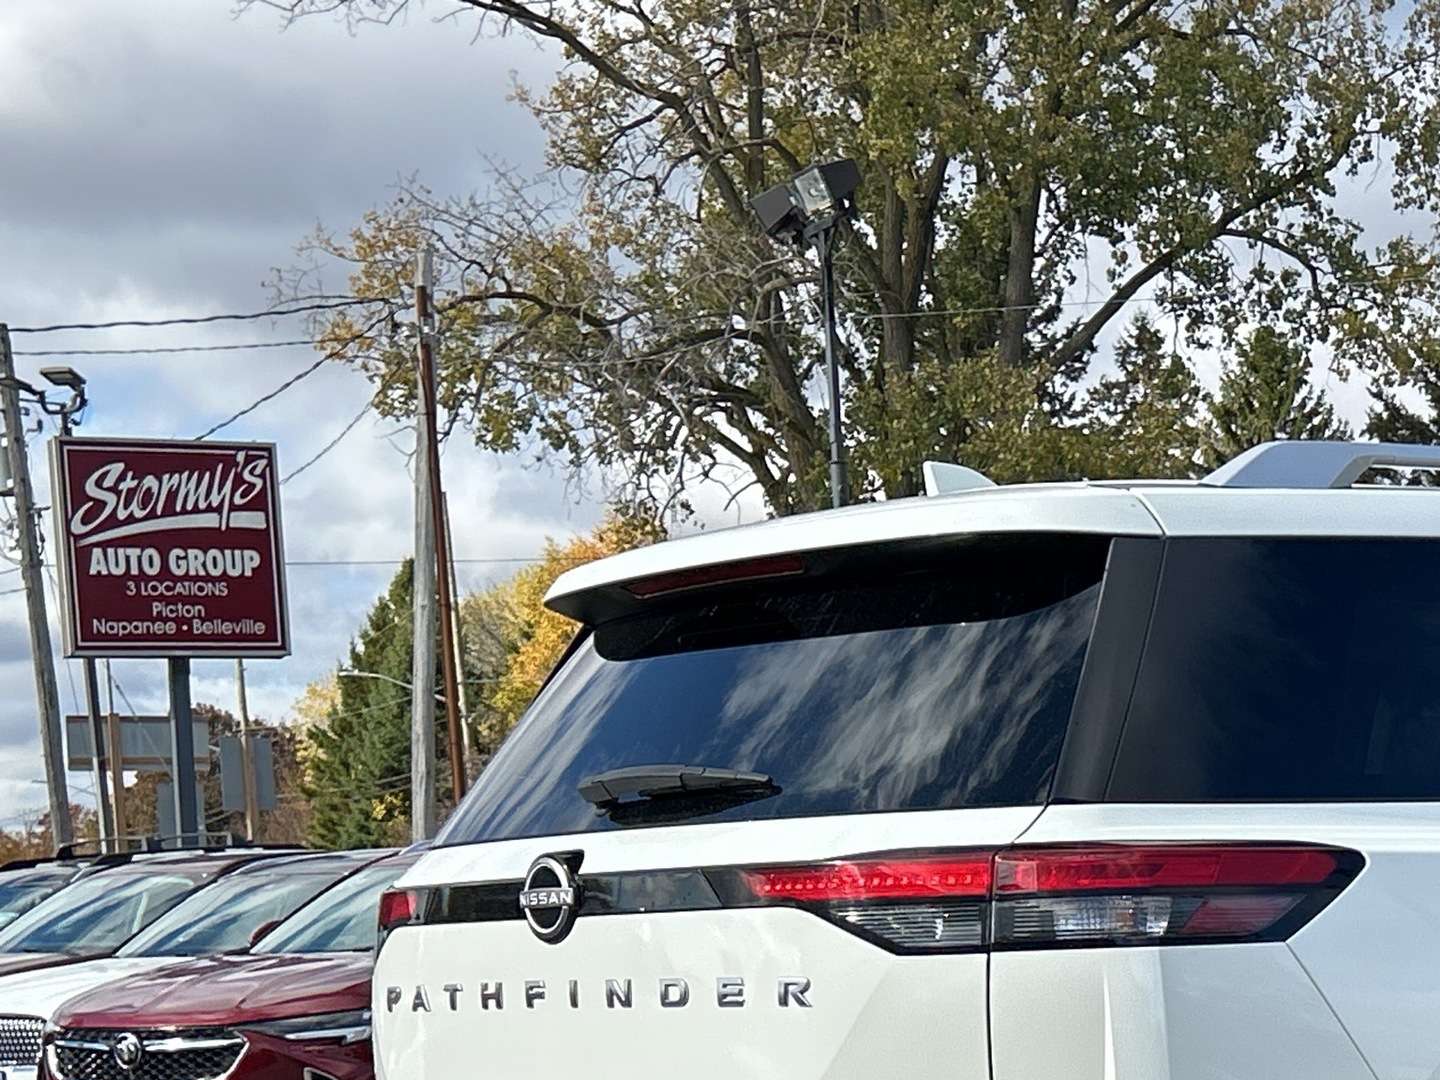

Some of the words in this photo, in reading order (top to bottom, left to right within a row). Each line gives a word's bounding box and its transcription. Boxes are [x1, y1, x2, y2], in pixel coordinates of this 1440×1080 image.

[70, 450, 268, 535] Stormy's
[89, 547, 161, 576] AUTO
[168, 549, 261, 577] GROUP
[126, 582, 136, 596] 3
[141, 582, 228, 597] LOCATIONS
[152, 602, 205, 618] Picton
[93, 619, 176, 636] Napanee
[193, 619, 266, 635] Belleville
[519, 890, 572, 907] NISSAN
[386, 976, 813, 1013] PATHFINDER
